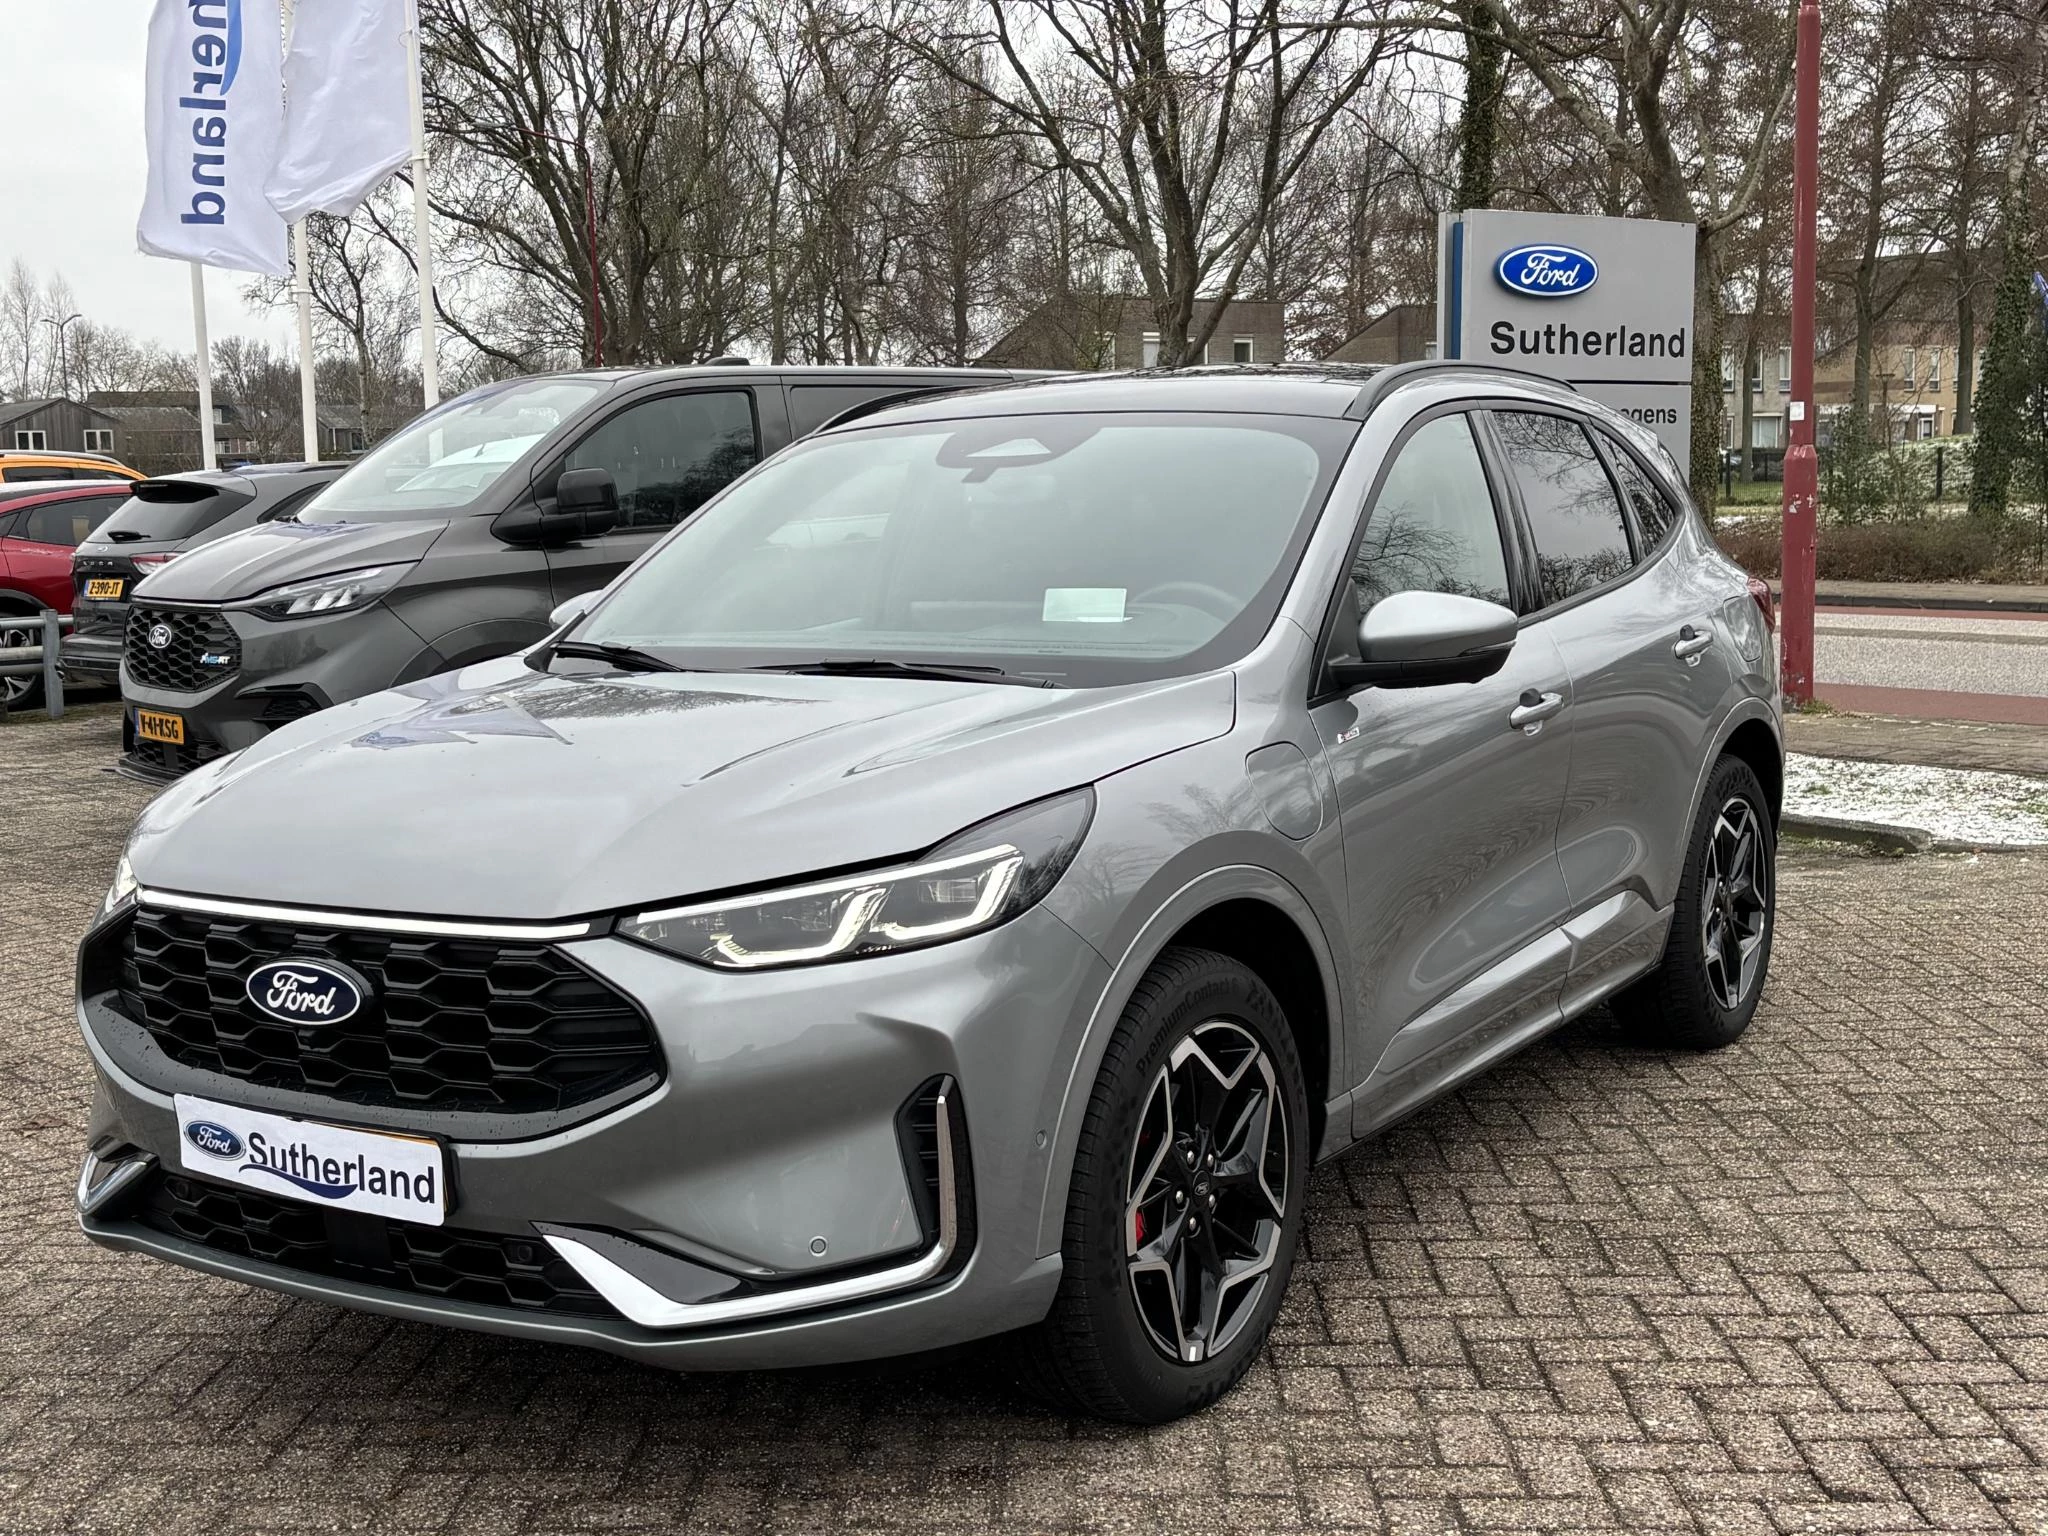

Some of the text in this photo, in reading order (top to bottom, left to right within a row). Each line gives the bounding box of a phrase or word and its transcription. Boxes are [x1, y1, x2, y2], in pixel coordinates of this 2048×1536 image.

[1521, 252, 1580, 287] Ford
[1490, 320, 1686, 358] Sutherland
[266, 970, 337, 1015] Ford
[196, 1125, 436, 1204] Ford Sutherland
